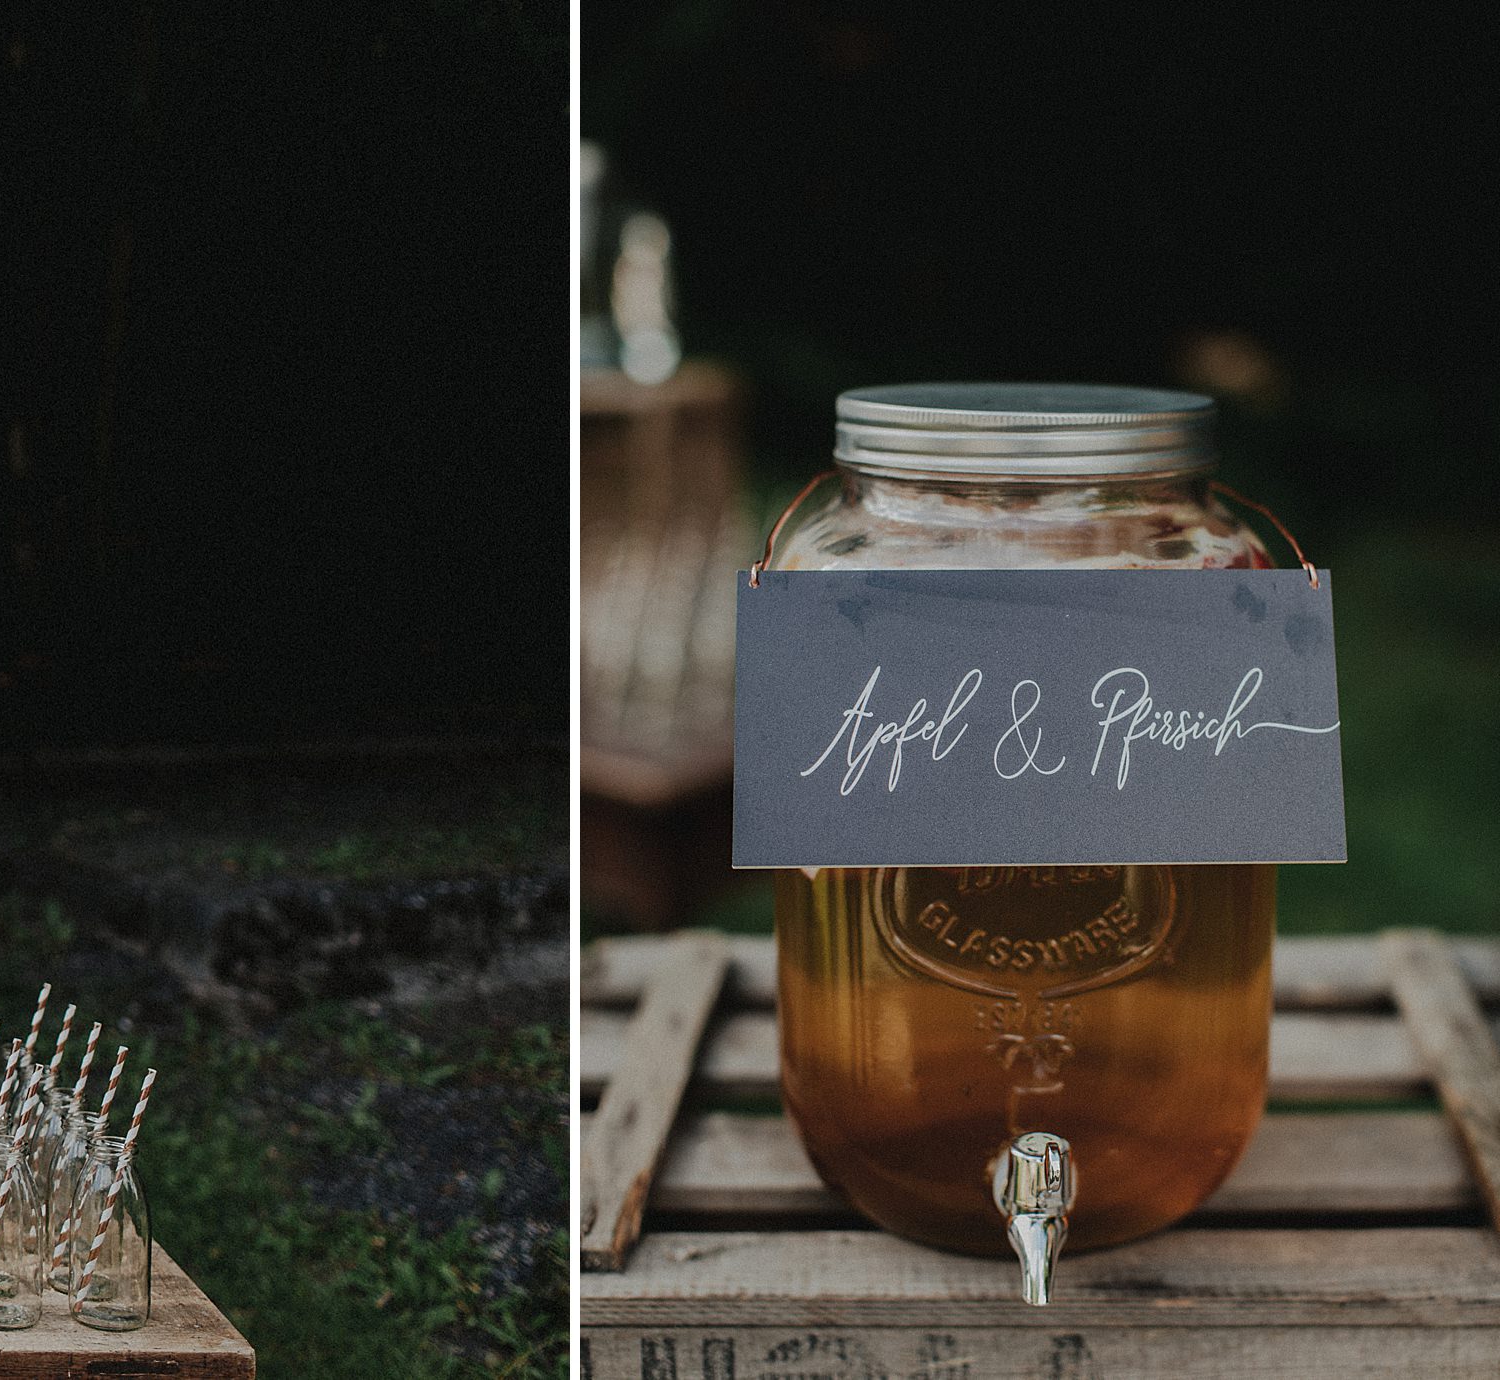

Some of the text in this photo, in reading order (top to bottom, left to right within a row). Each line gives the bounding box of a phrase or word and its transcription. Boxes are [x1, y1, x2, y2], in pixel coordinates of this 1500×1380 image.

[800, 665, 1341, 796] Apfel & Pfirsich
[917, 896, 1138, 968] GLASSWARE
